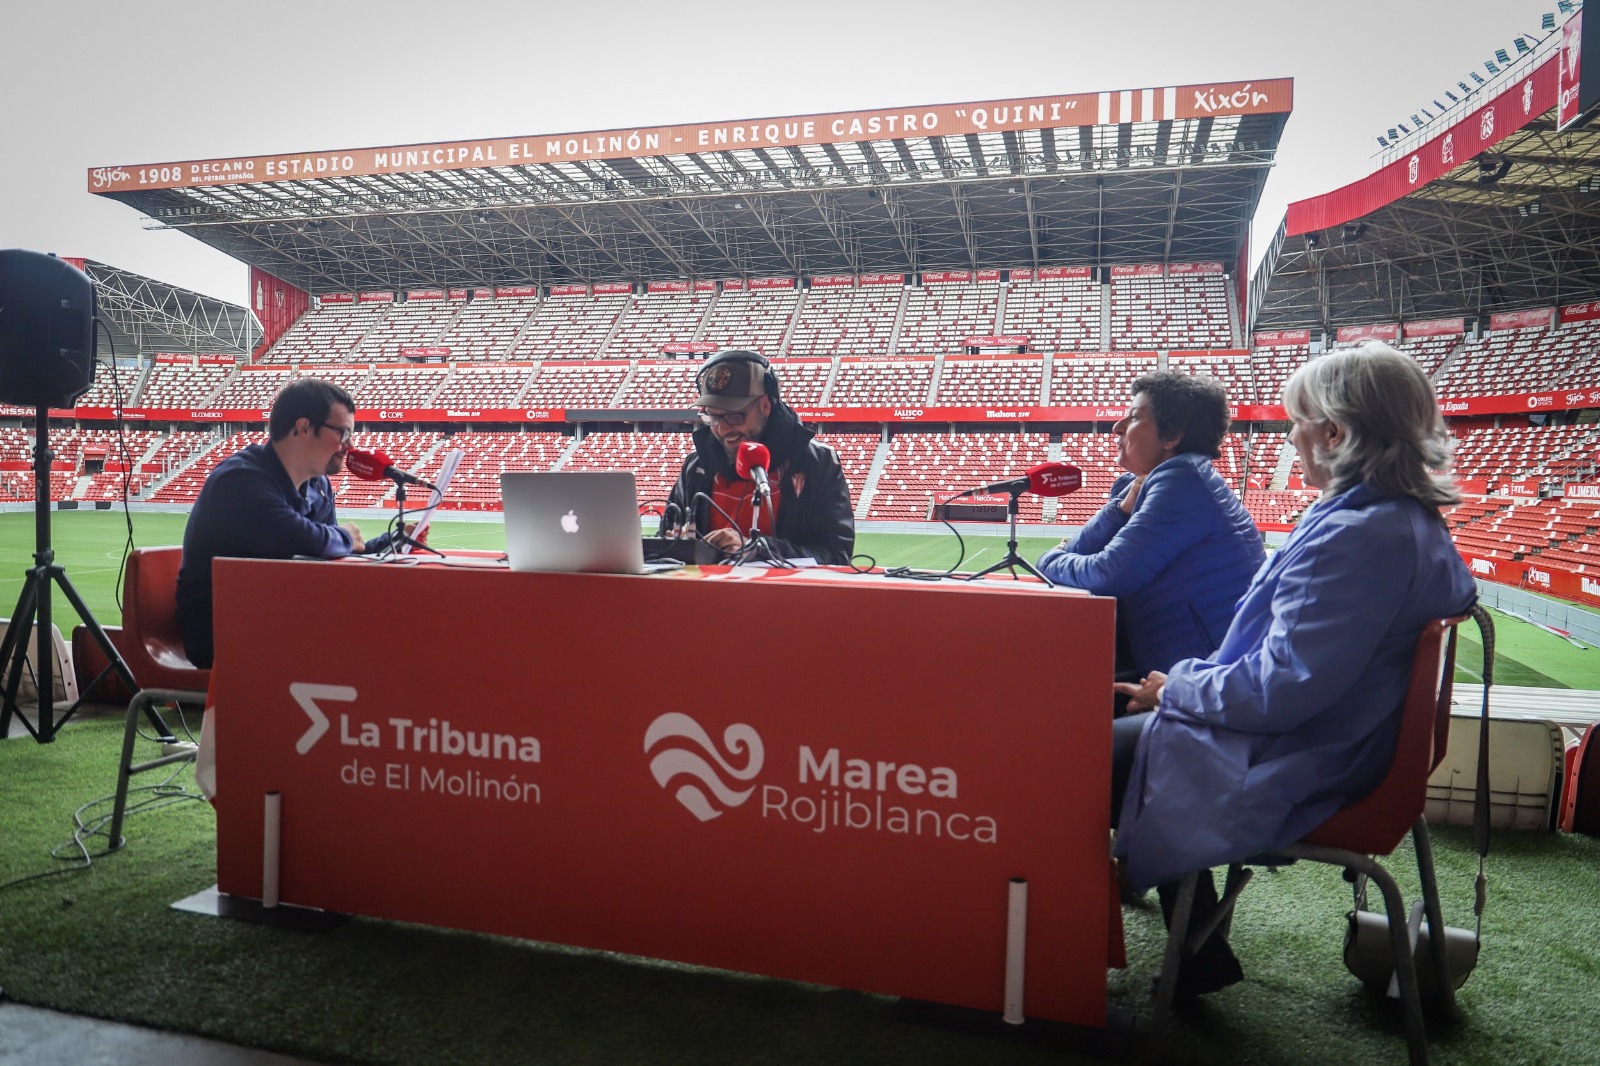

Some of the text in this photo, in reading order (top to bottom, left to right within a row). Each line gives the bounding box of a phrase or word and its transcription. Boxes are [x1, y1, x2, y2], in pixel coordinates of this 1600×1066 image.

[266, 156, 355, 176] ESTADIO
[375, 146, 498, 168] MUNICIPAL
[509, 143, 534, 159] EL
[546, 131, 660, 157] MOLINÓN
[698, 121, 815, 146] ENRIQUE
[831, 112, 939, 136] CASTRO
[139, 167, 182, 184] 1908
[191, 160, 255, 174] DECANO
[204, 174, 226, 182] FÚTBOL
[1445, 402, 1469, 412] España
[1568, 486, 1600, 497] ALIMERK
[340, 714, 541, 763] La Tribuna
[341, 759, 541, 803] de El Molinón
[799, 745, 958, 798] Marea
[762, 785, 997, 843] Rojiblanca
